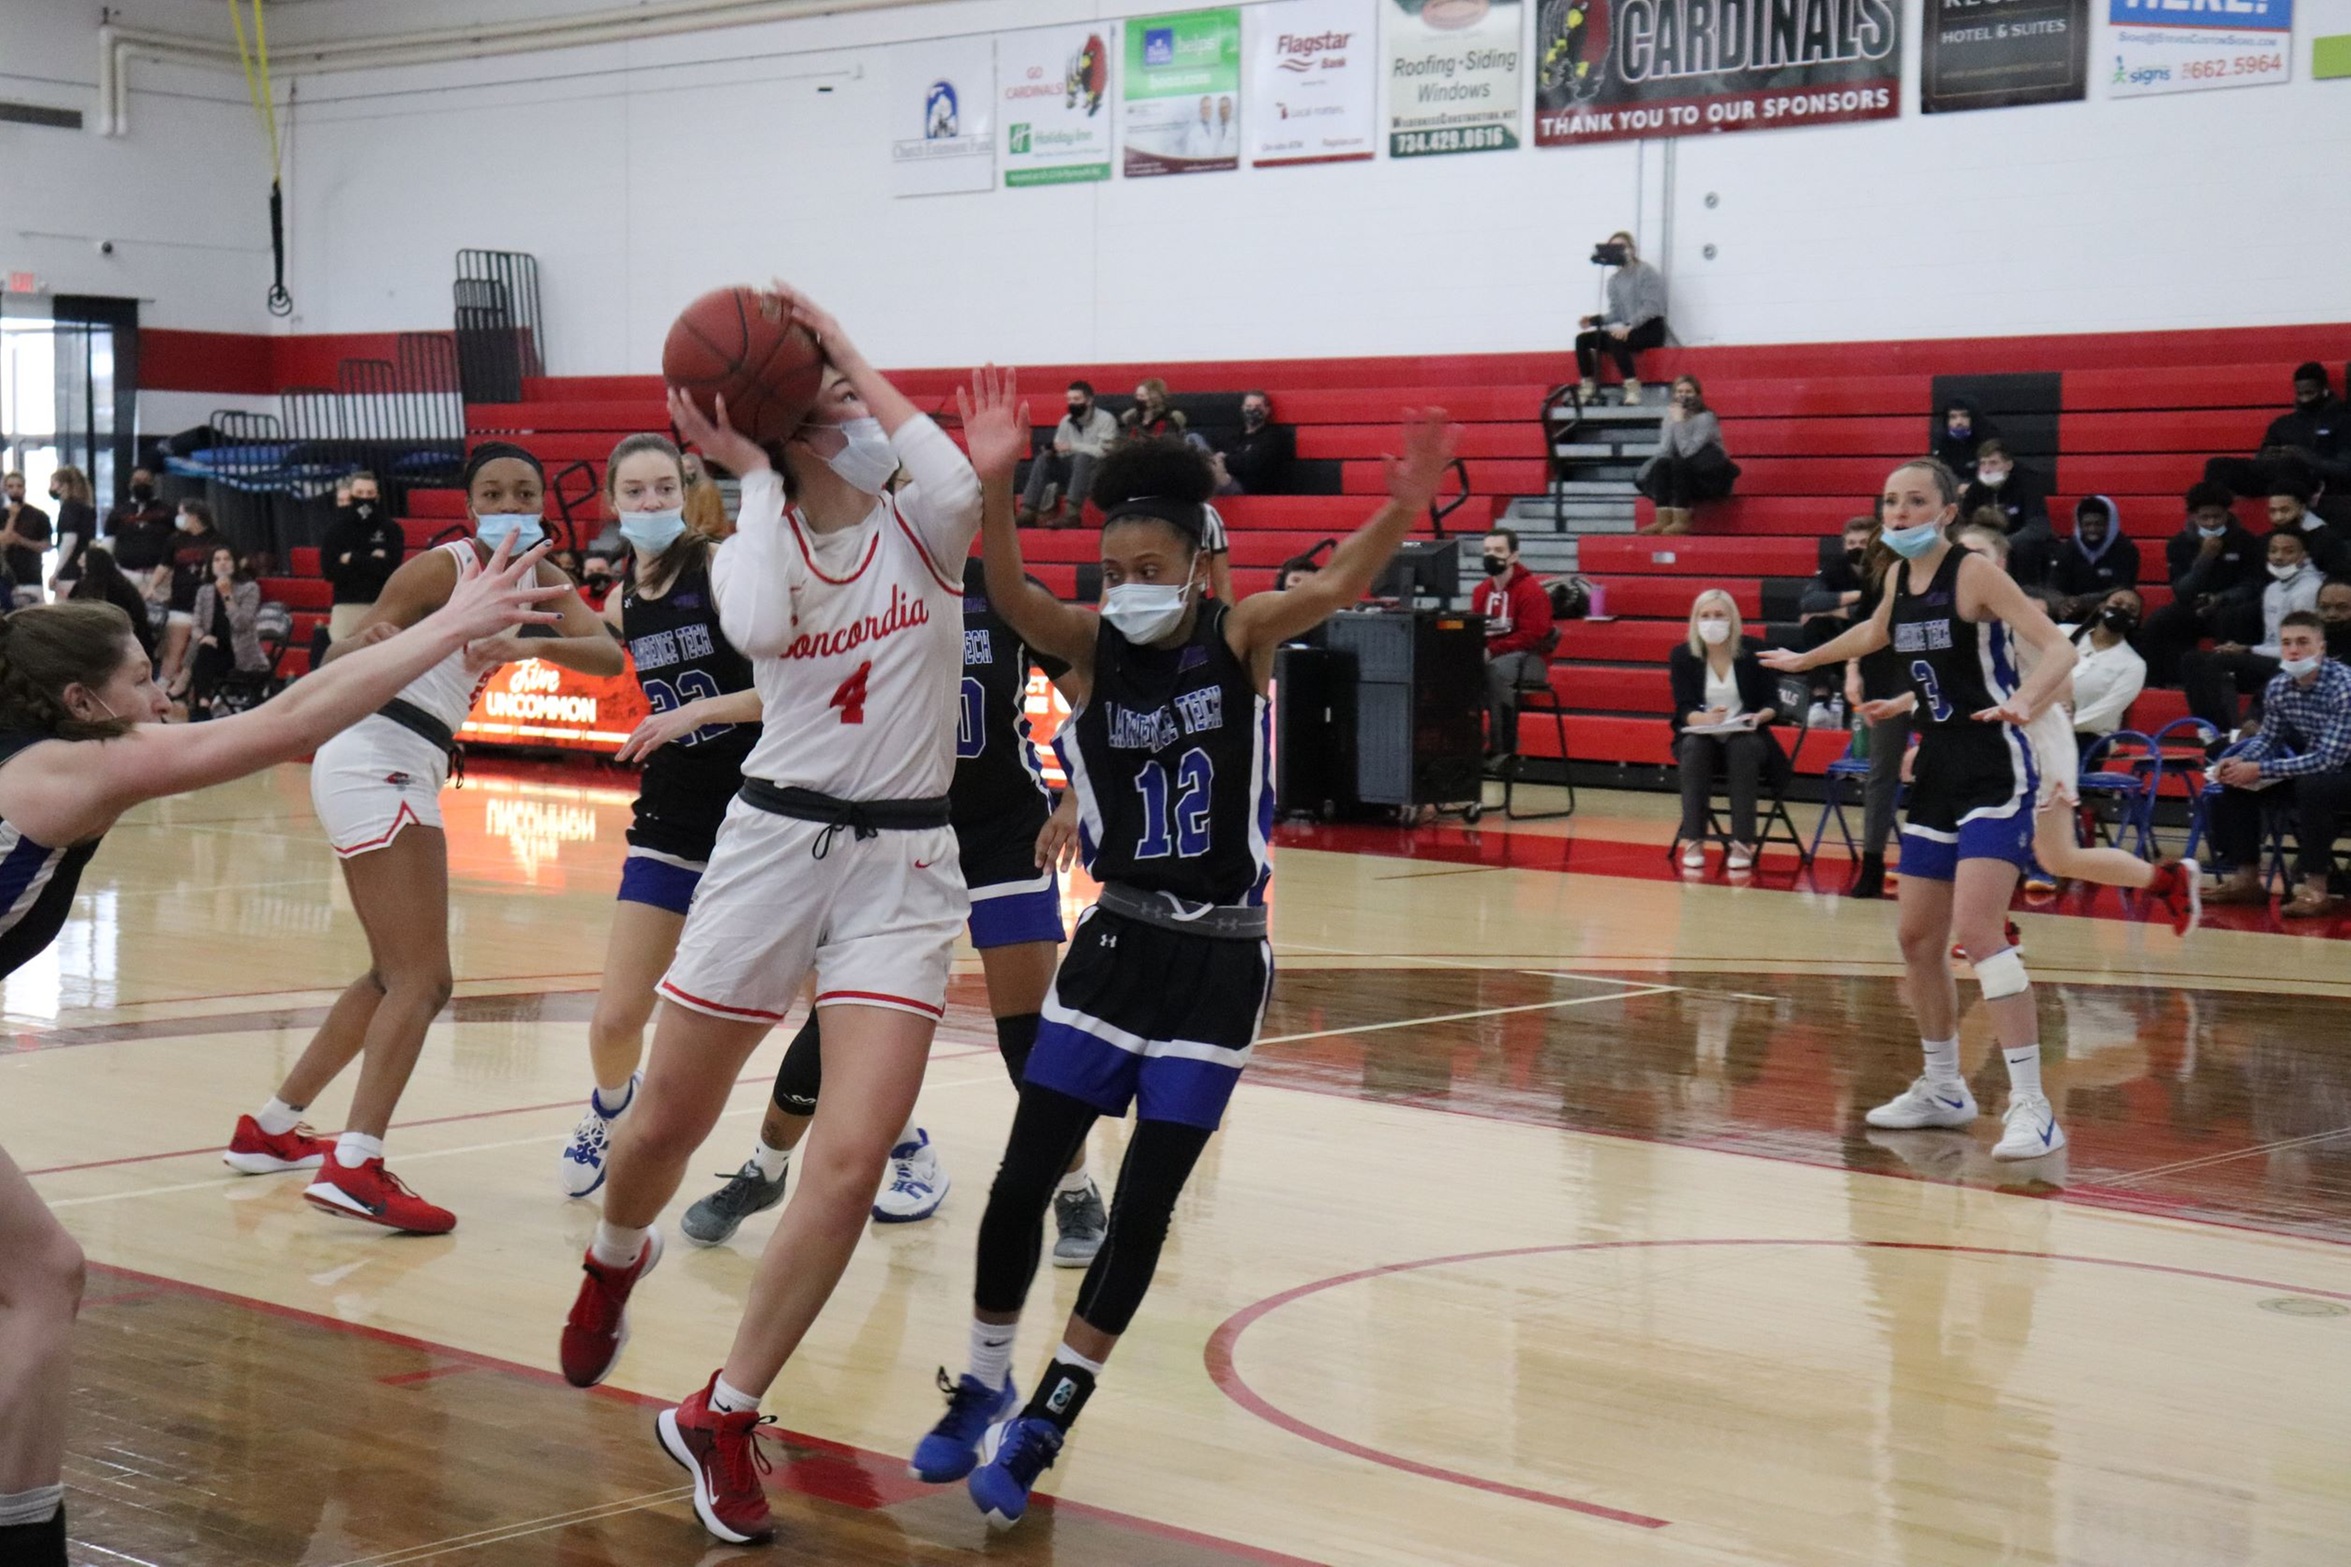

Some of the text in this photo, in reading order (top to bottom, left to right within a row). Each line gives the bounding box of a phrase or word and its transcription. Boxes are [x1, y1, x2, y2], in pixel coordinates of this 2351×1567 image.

[1277, 31, 1354, 57] Flagstar
[1619, 0, 1895, 84] CARDINALS
[1941, 19, 2067, 44] HOTEL & SUITES
[1026, 67, 1044, 79] GO
[1321, 57, 1346, 69] Bank
[1393, 49, 1518, 78] Roofing Siding
[2130, 67, 2172, 84] signs
[1418, 81, 1492, 103] Windows
[1540, 88, 1890, 137] THANK YOU TO OUR SPONSORS
[1396, 127, 1504, 153] 734.429.0616
[779, 583, 930, 661] oncordia
[675, 623, 715, 661] TECH
[486, 691, 597, 723] UNCOMMON
[829, 661, 872, 725] 4
[1911, 660, 1954, 722] 3
[1174, 685, 1223, 734] TECH
[1134, 747, 1214, 860] 12
